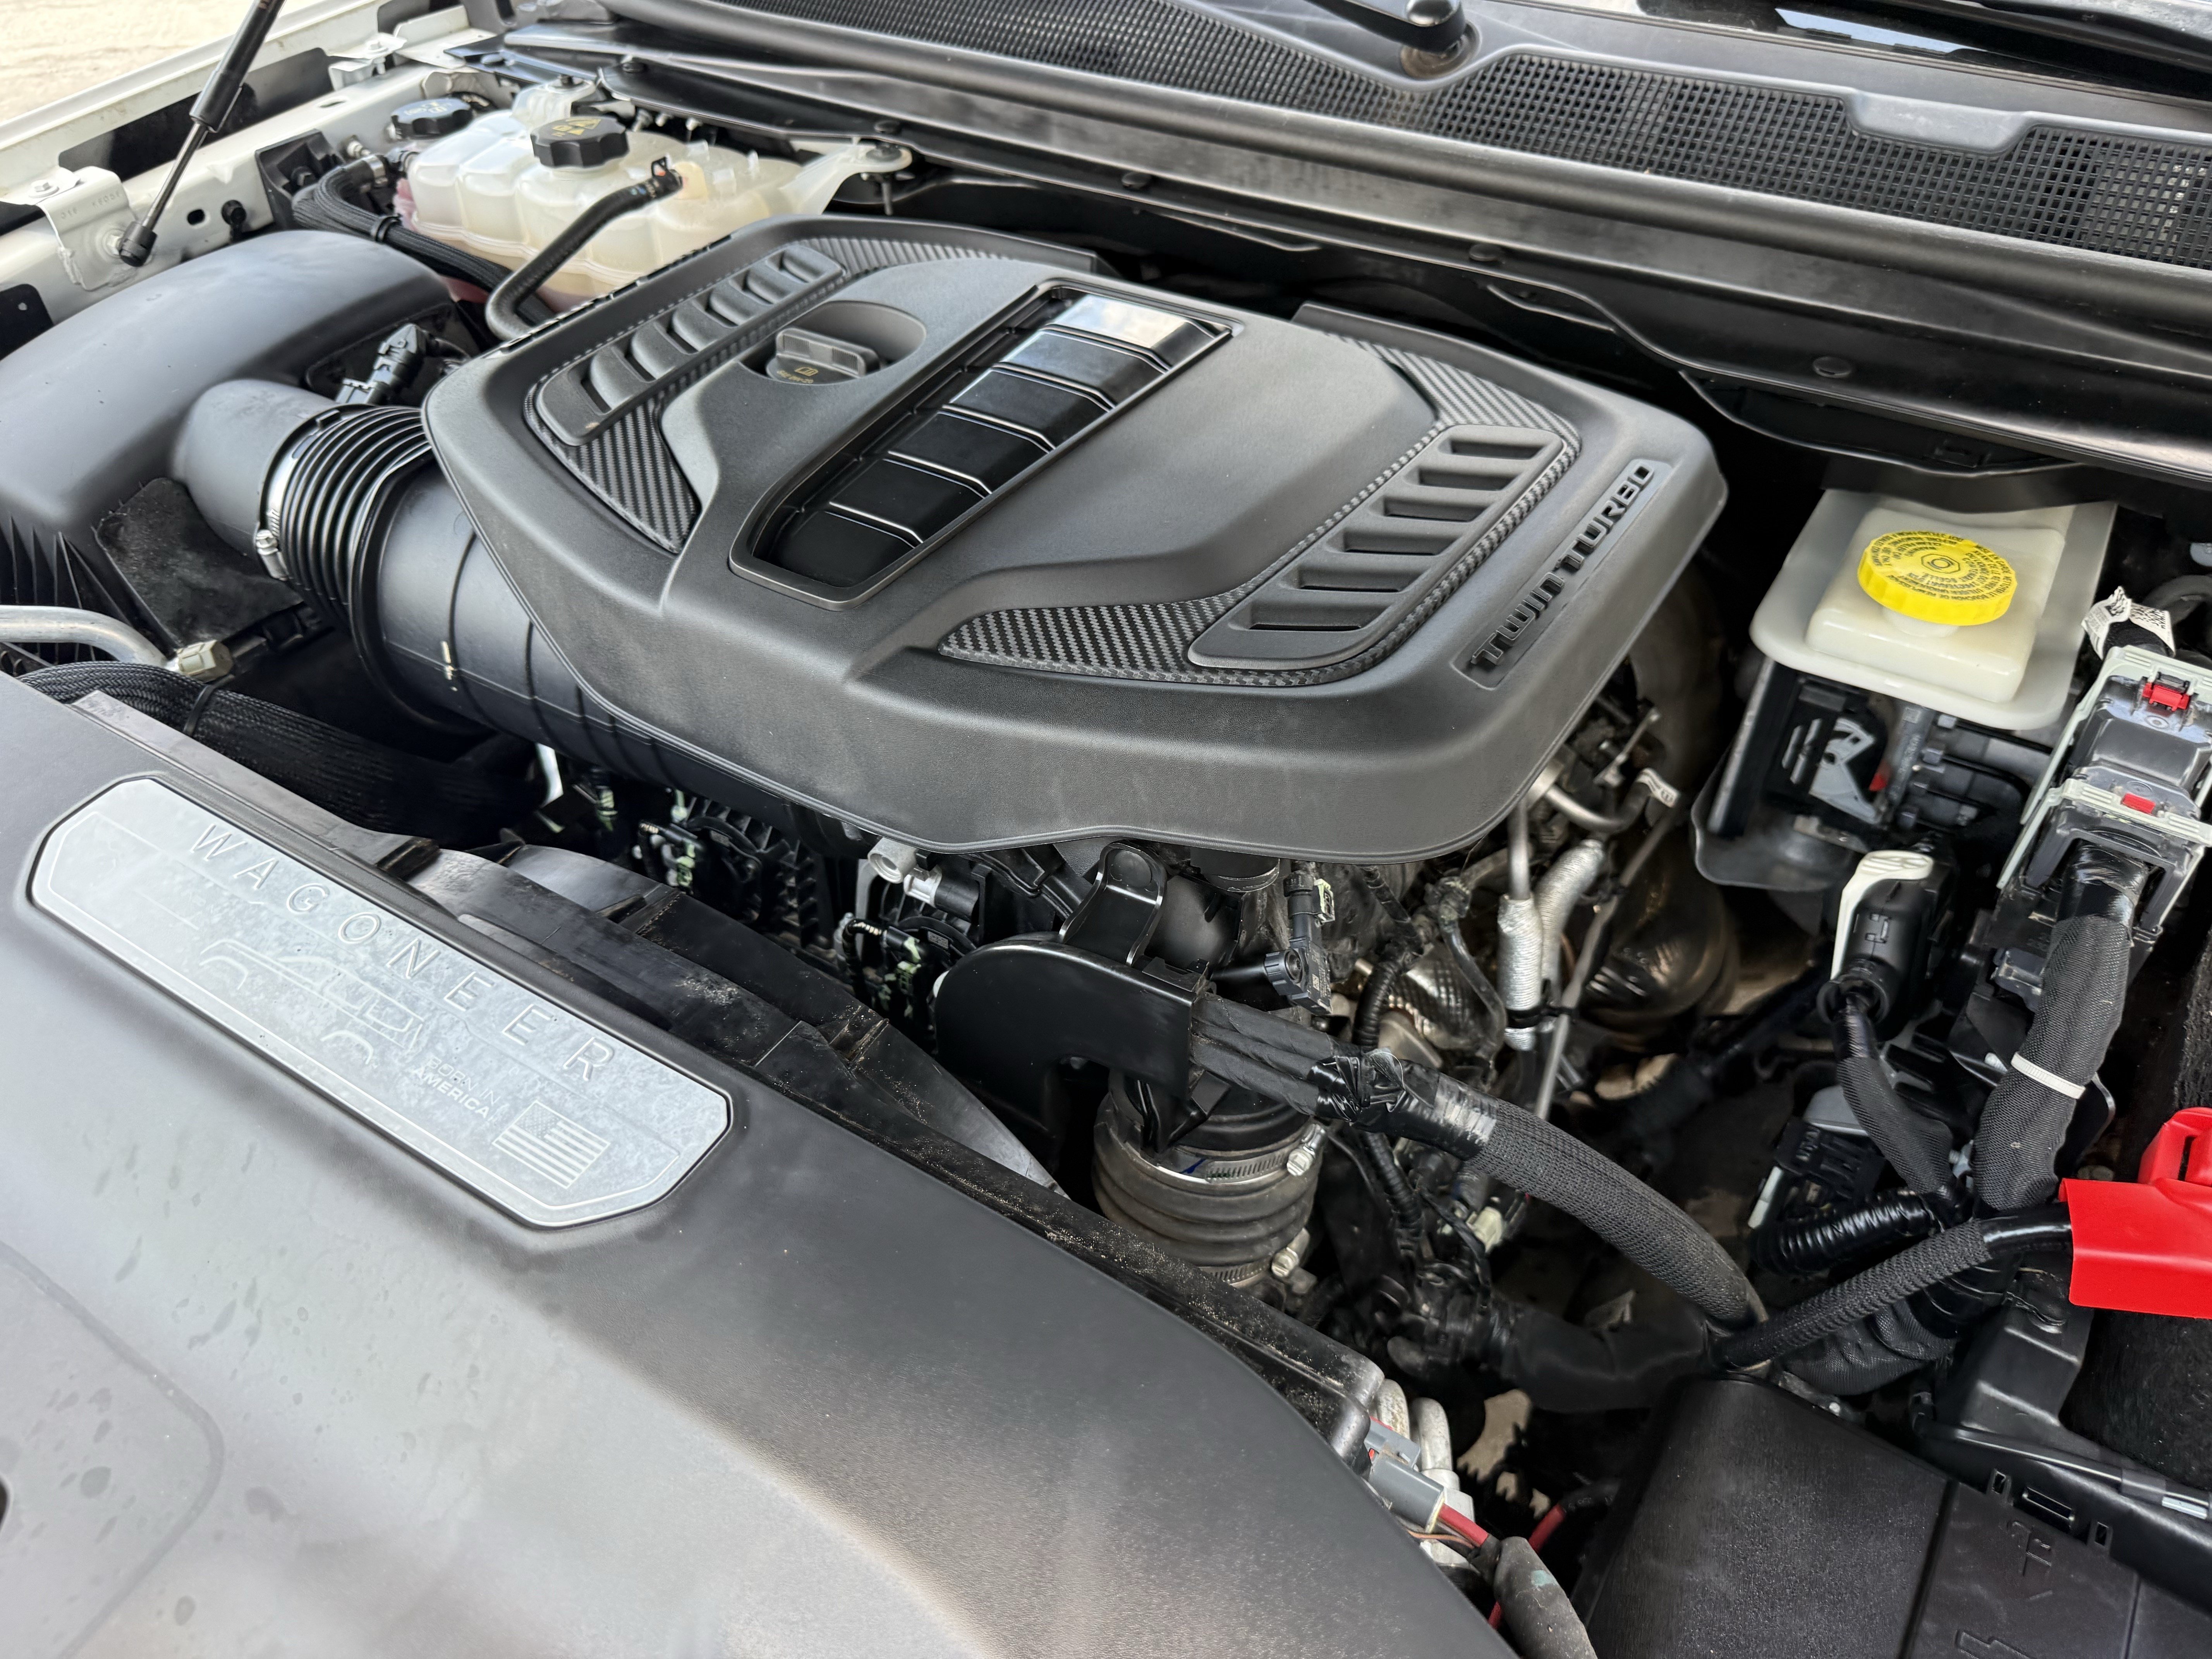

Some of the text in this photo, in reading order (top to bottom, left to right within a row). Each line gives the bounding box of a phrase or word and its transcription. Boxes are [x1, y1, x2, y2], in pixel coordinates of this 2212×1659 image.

[1471, 465, 1654, 666] TWIN TURBO
[189, 823, 618, 1083] WAGONEER
[411, 1066, 489, 1118] AMERICA
[426, 1054, 501, 1106] BORN IN
